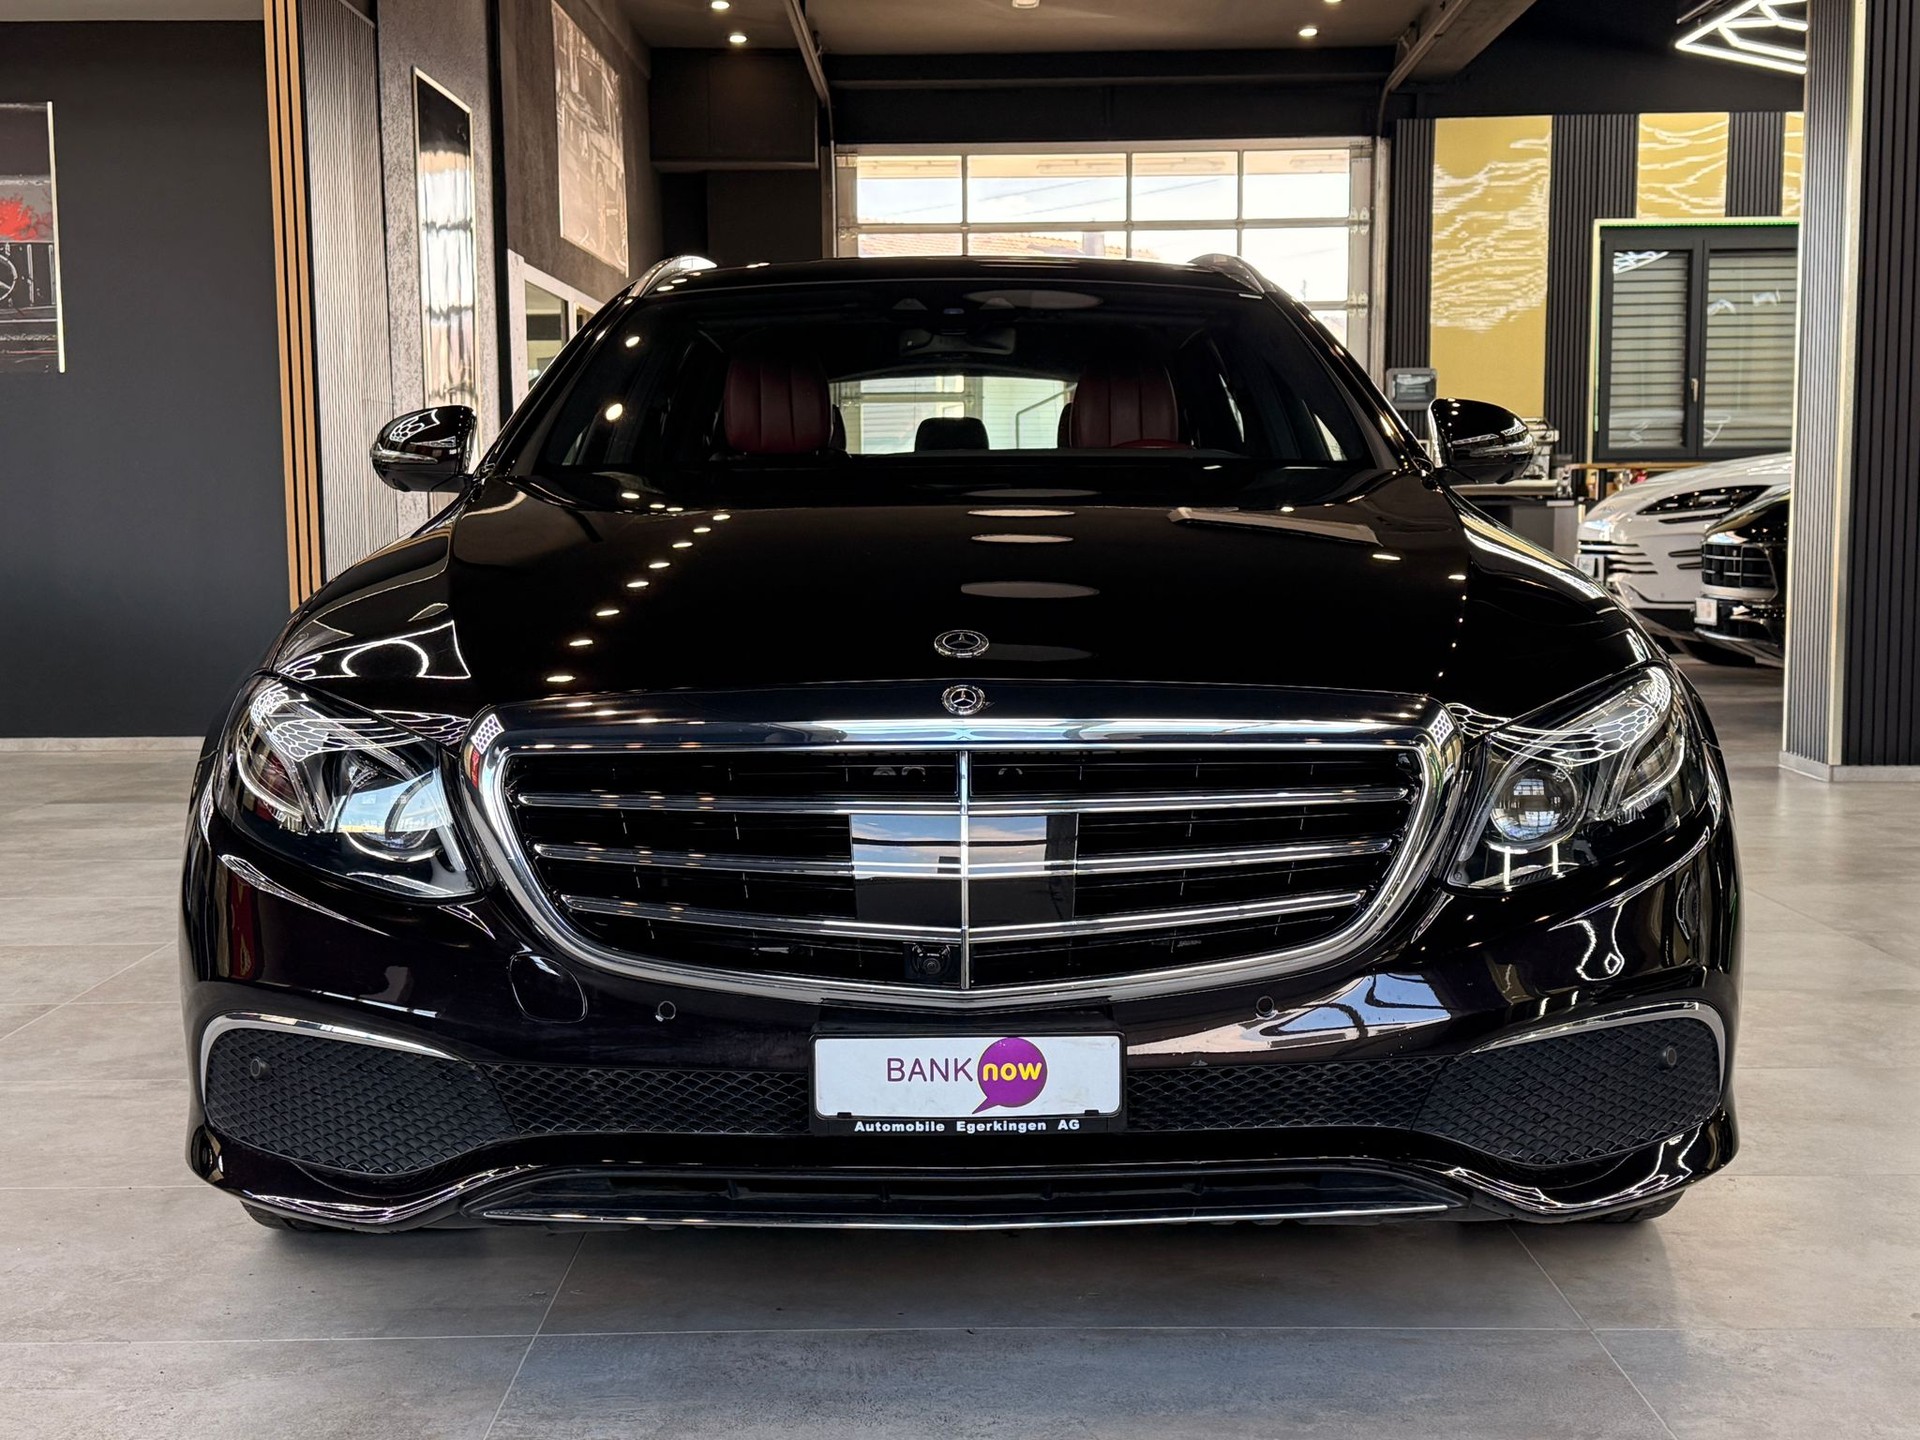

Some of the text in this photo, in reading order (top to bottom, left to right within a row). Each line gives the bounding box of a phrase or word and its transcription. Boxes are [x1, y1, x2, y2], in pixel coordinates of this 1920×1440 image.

[887, 1057, 1042, 1081] BANK now
[854, 1120, 1080, 1134] Automobile Egerkingen AG
